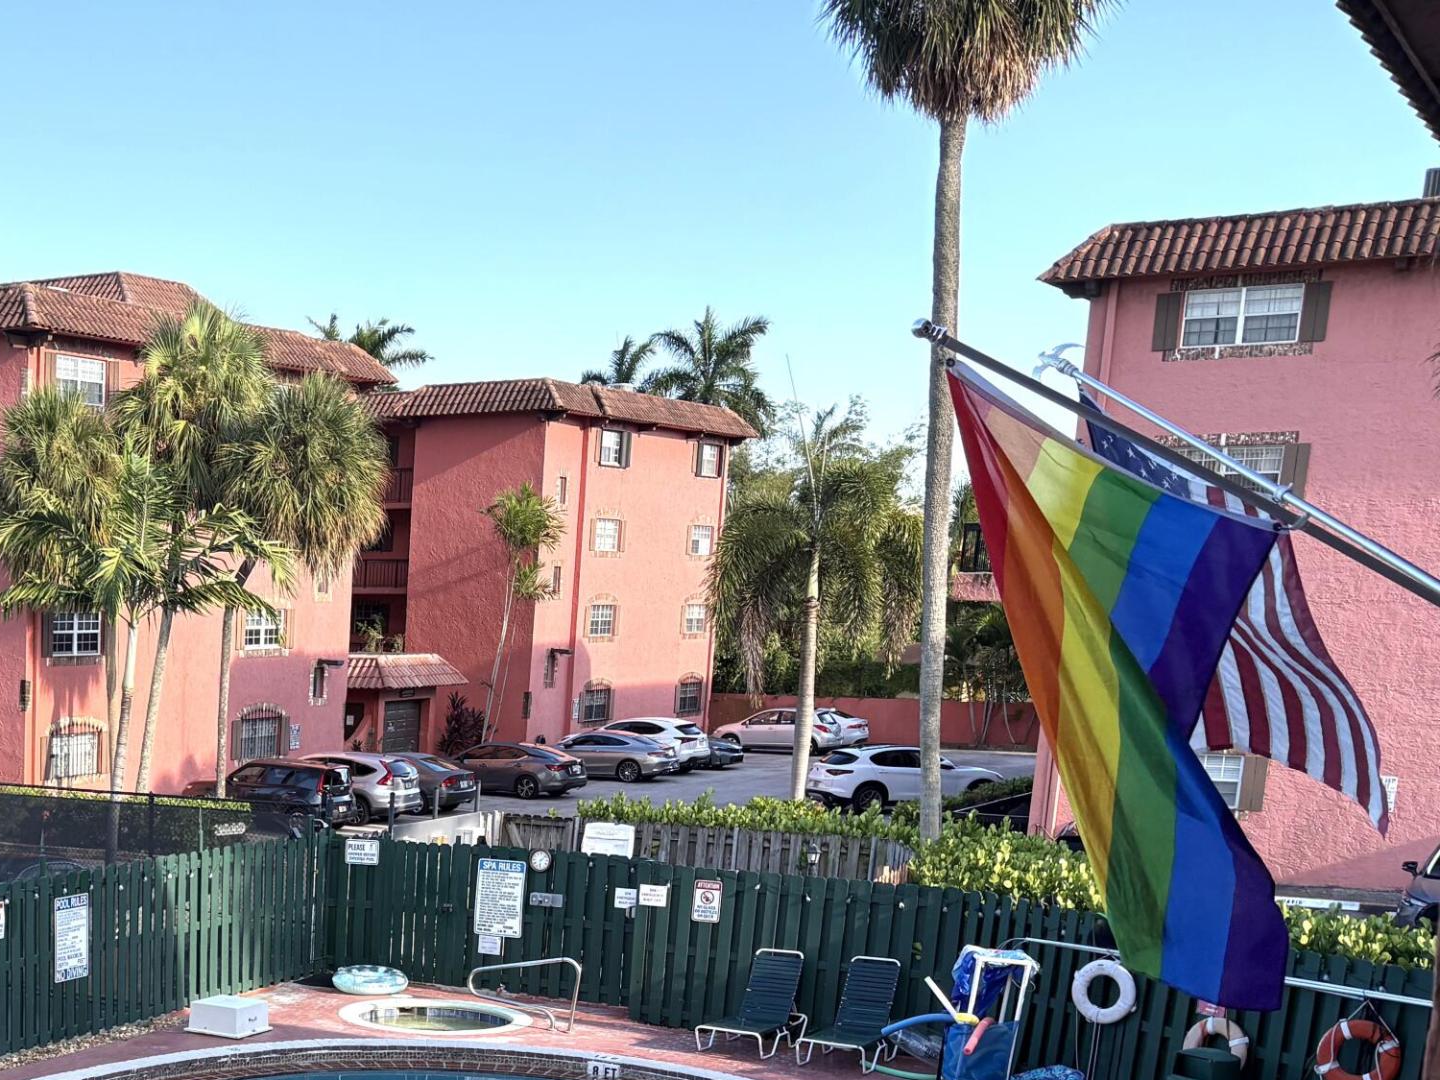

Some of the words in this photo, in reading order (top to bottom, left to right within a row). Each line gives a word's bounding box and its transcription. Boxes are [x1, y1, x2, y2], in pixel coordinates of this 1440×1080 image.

[482, 861, 497, 870] SPA
[498, 862, 521, 871] RULES
[56, 898, 70, 911] POOL
[70, 895, 87, 908] RULES
[66, 965, 87, 979] DIVING
[604, 1067, 617, 1080] FT
